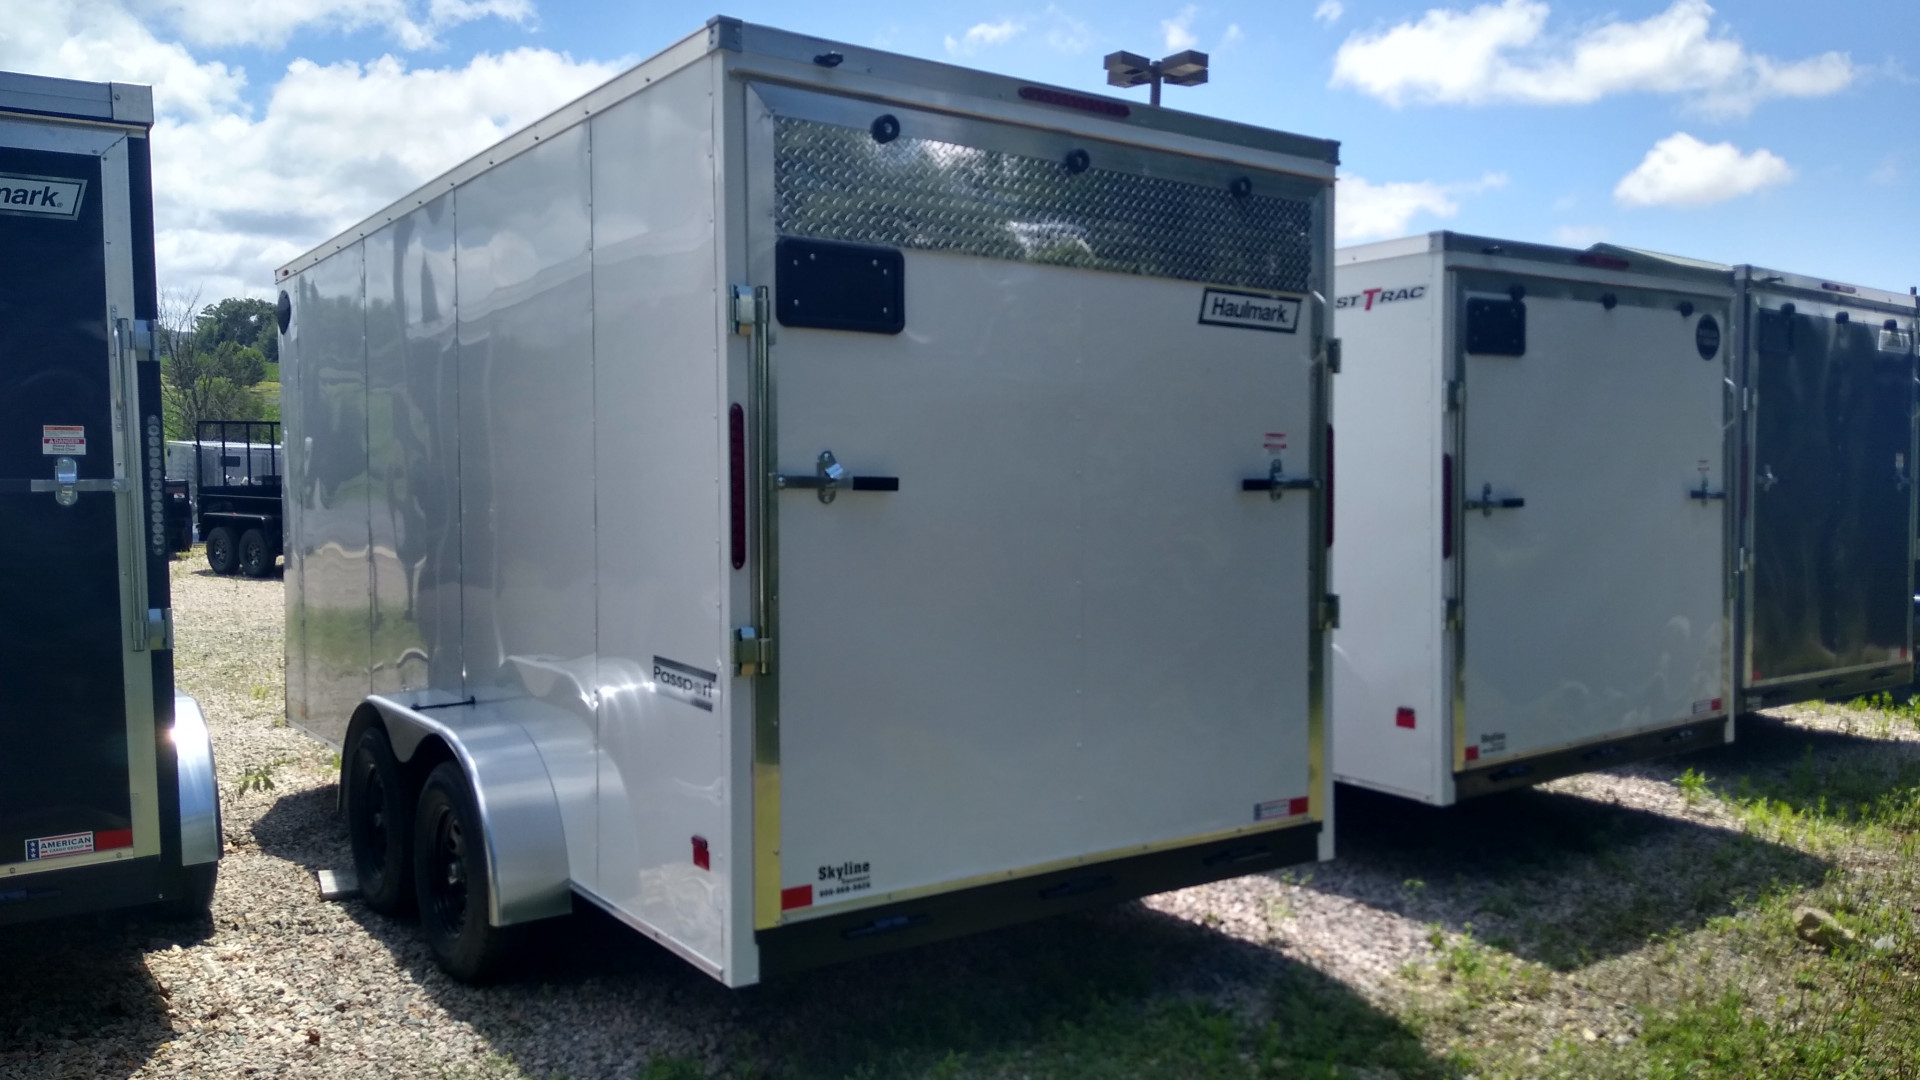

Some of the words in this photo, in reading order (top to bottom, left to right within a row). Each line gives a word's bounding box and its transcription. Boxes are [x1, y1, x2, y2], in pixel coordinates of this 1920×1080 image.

[1212, 297, 1287, 323] Haulmark
[40, 836, 92, 850] AMERICAN
[818, 861, 870, 881] Skyline
